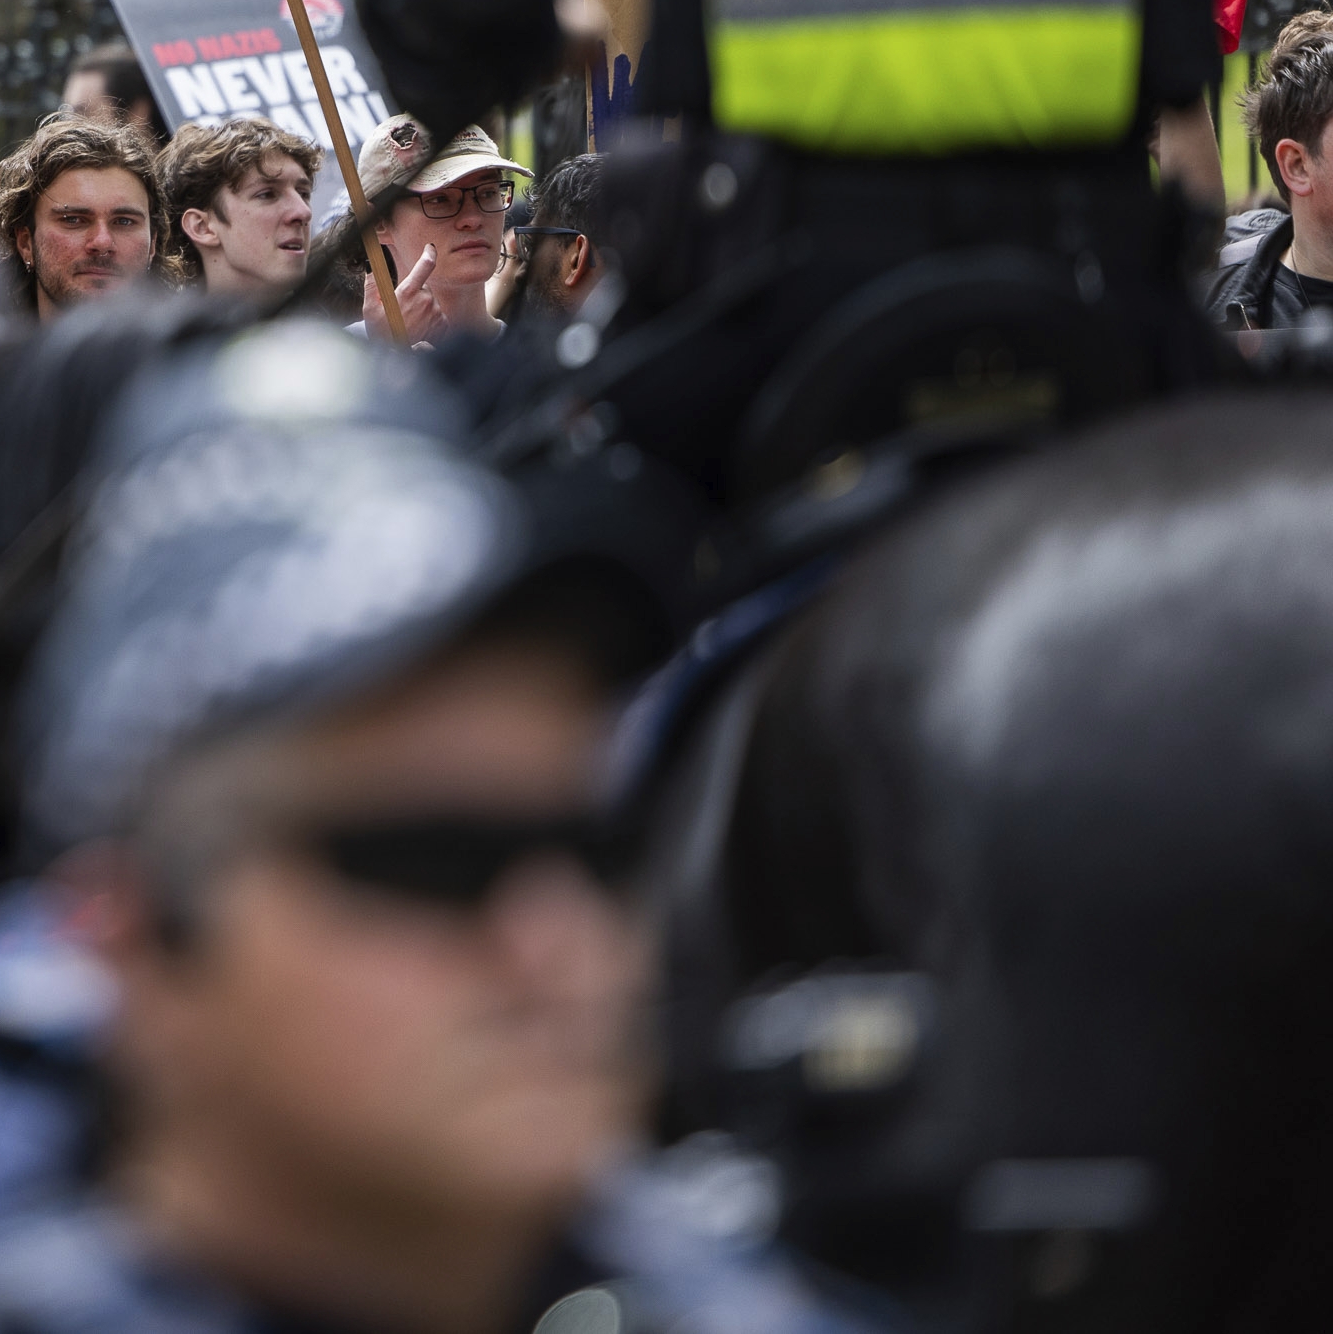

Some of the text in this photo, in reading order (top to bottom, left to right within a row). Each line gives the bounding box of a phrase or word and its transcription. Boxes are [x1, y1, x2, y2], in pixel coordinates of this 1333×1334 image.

[151, 27, 282, 67] NO NAZIS
[164, 45, 370, 118] NEVER
